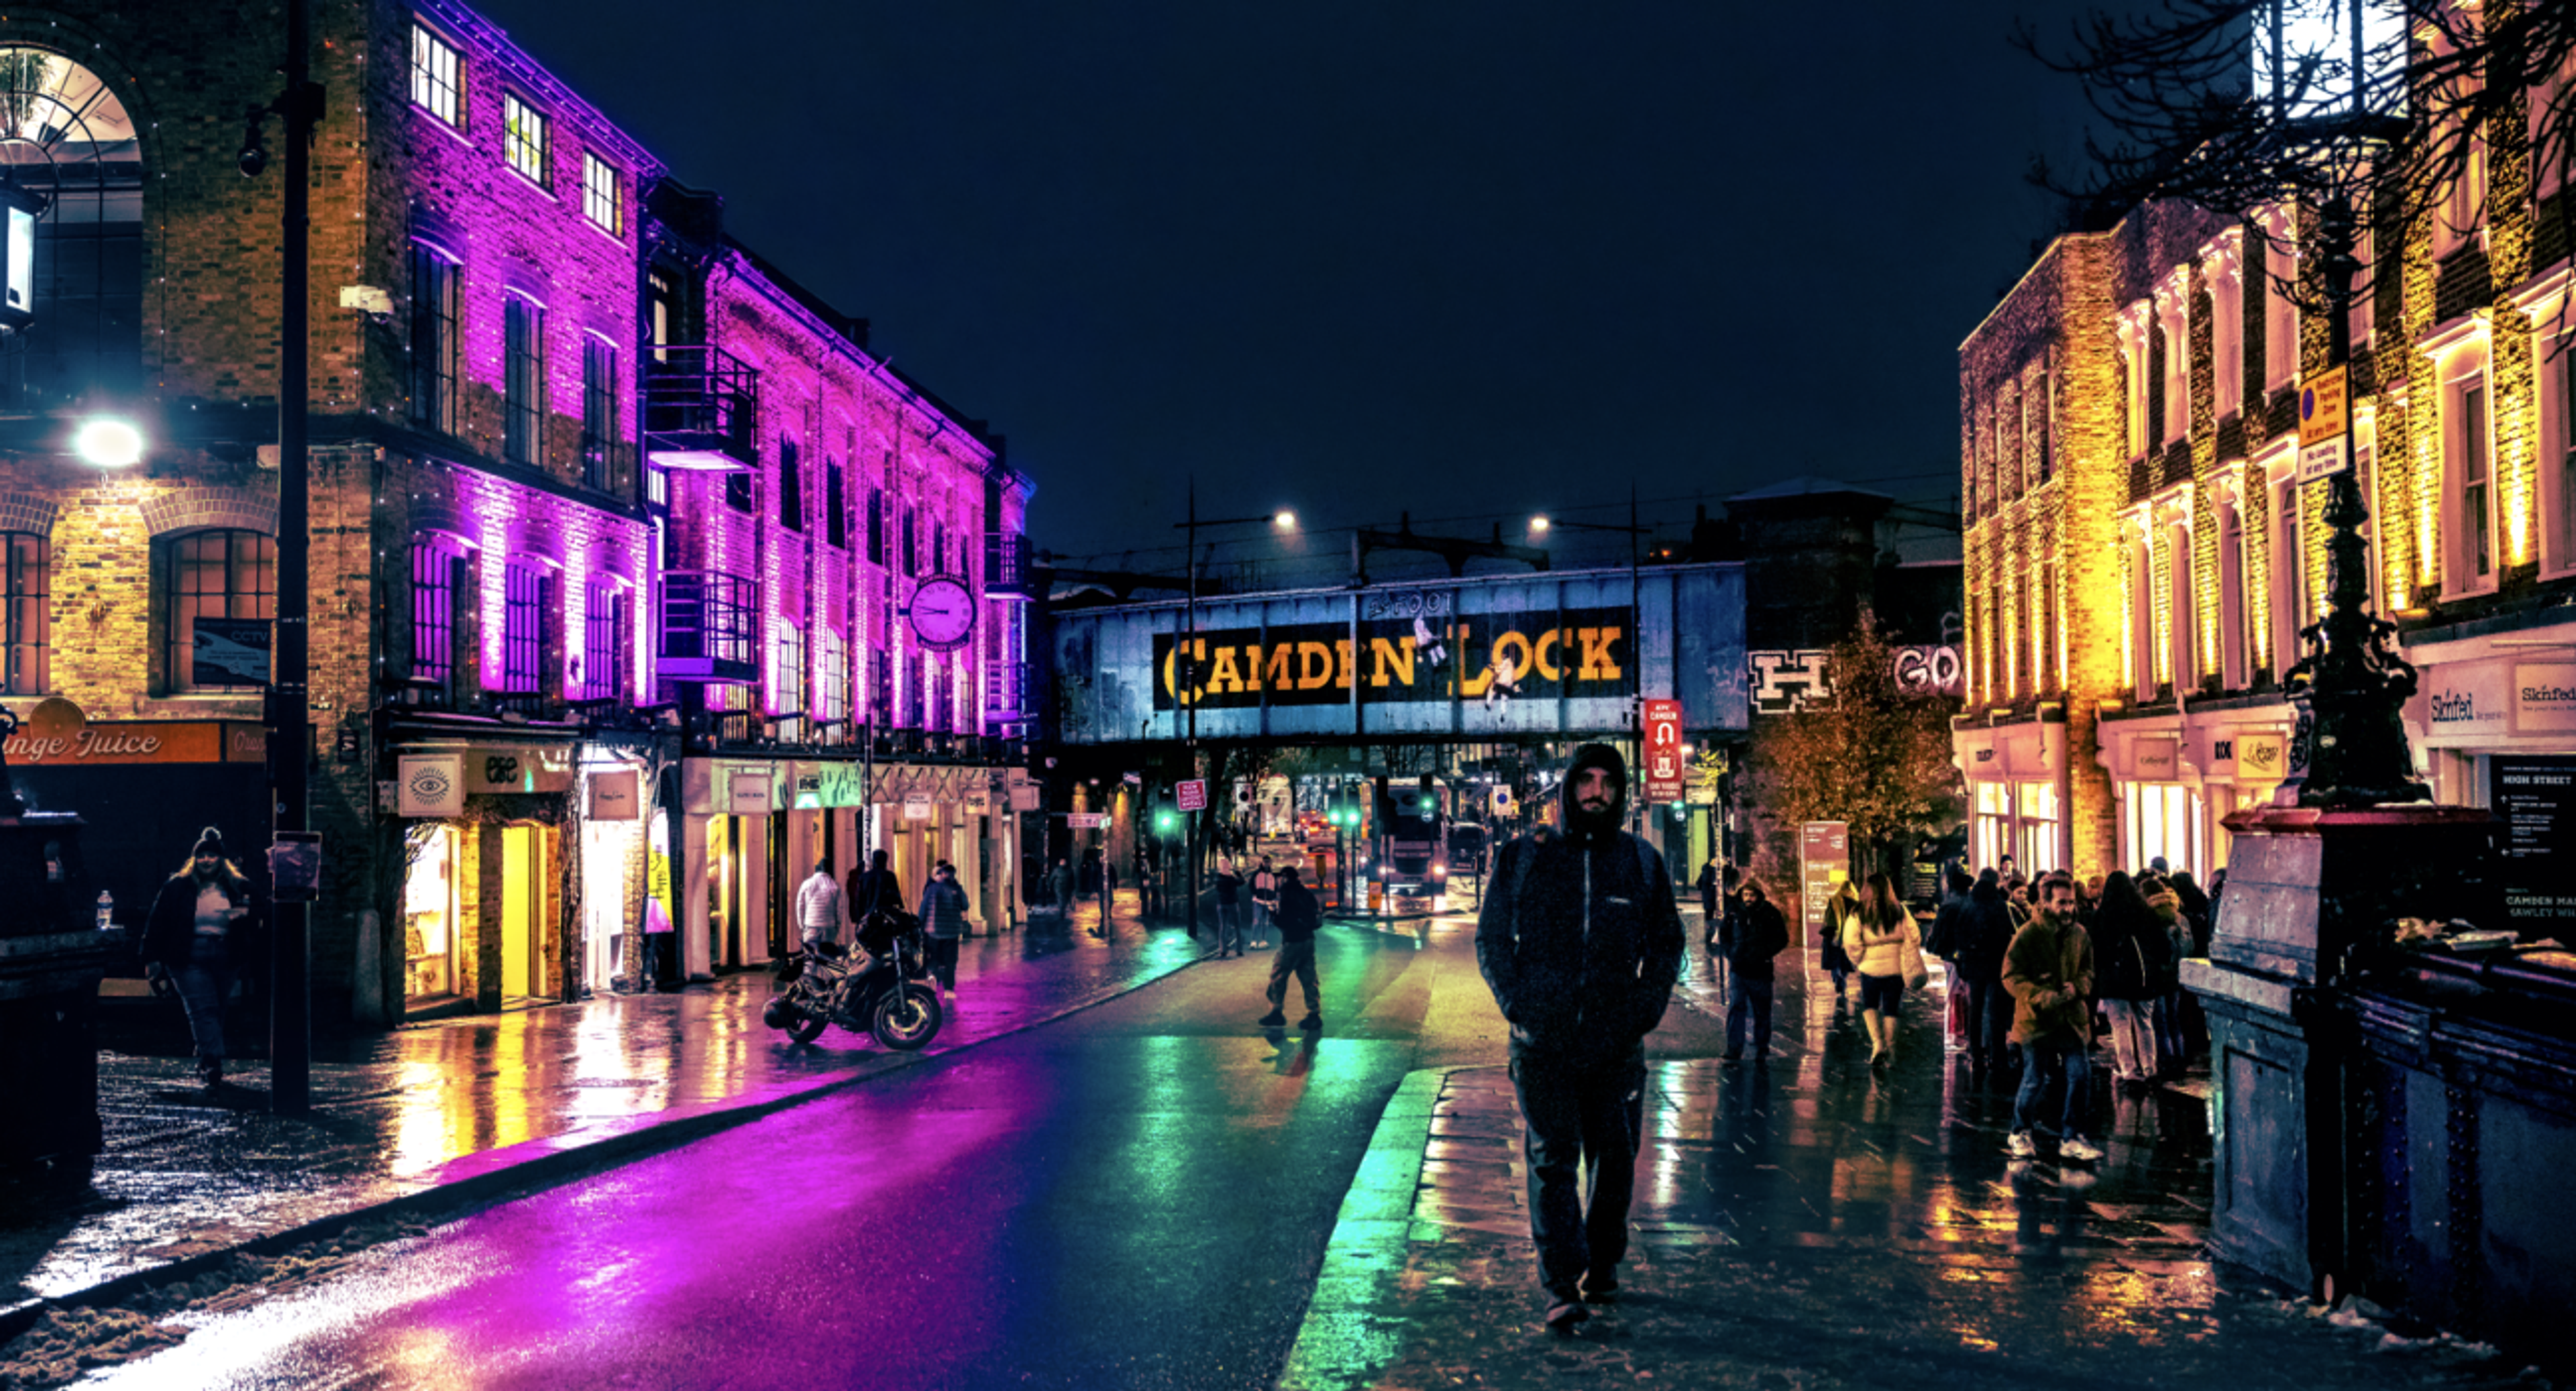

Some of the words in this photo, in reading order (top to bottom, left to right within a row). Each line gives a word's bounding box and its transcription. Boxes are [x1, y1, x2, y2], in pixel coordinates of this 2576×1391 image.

[231, 630, 268, 642] CCTV
[1447, 624, 1621, 696] LOCK
[76, 729, 162, 757] Juice
[2502, 775, 2530, 784] HIGH
[2532, 775, 2571, 785] STREET
[2506, 895, 2553, 905] CAMDEN
[2556, 896, 2576, 905] MA
